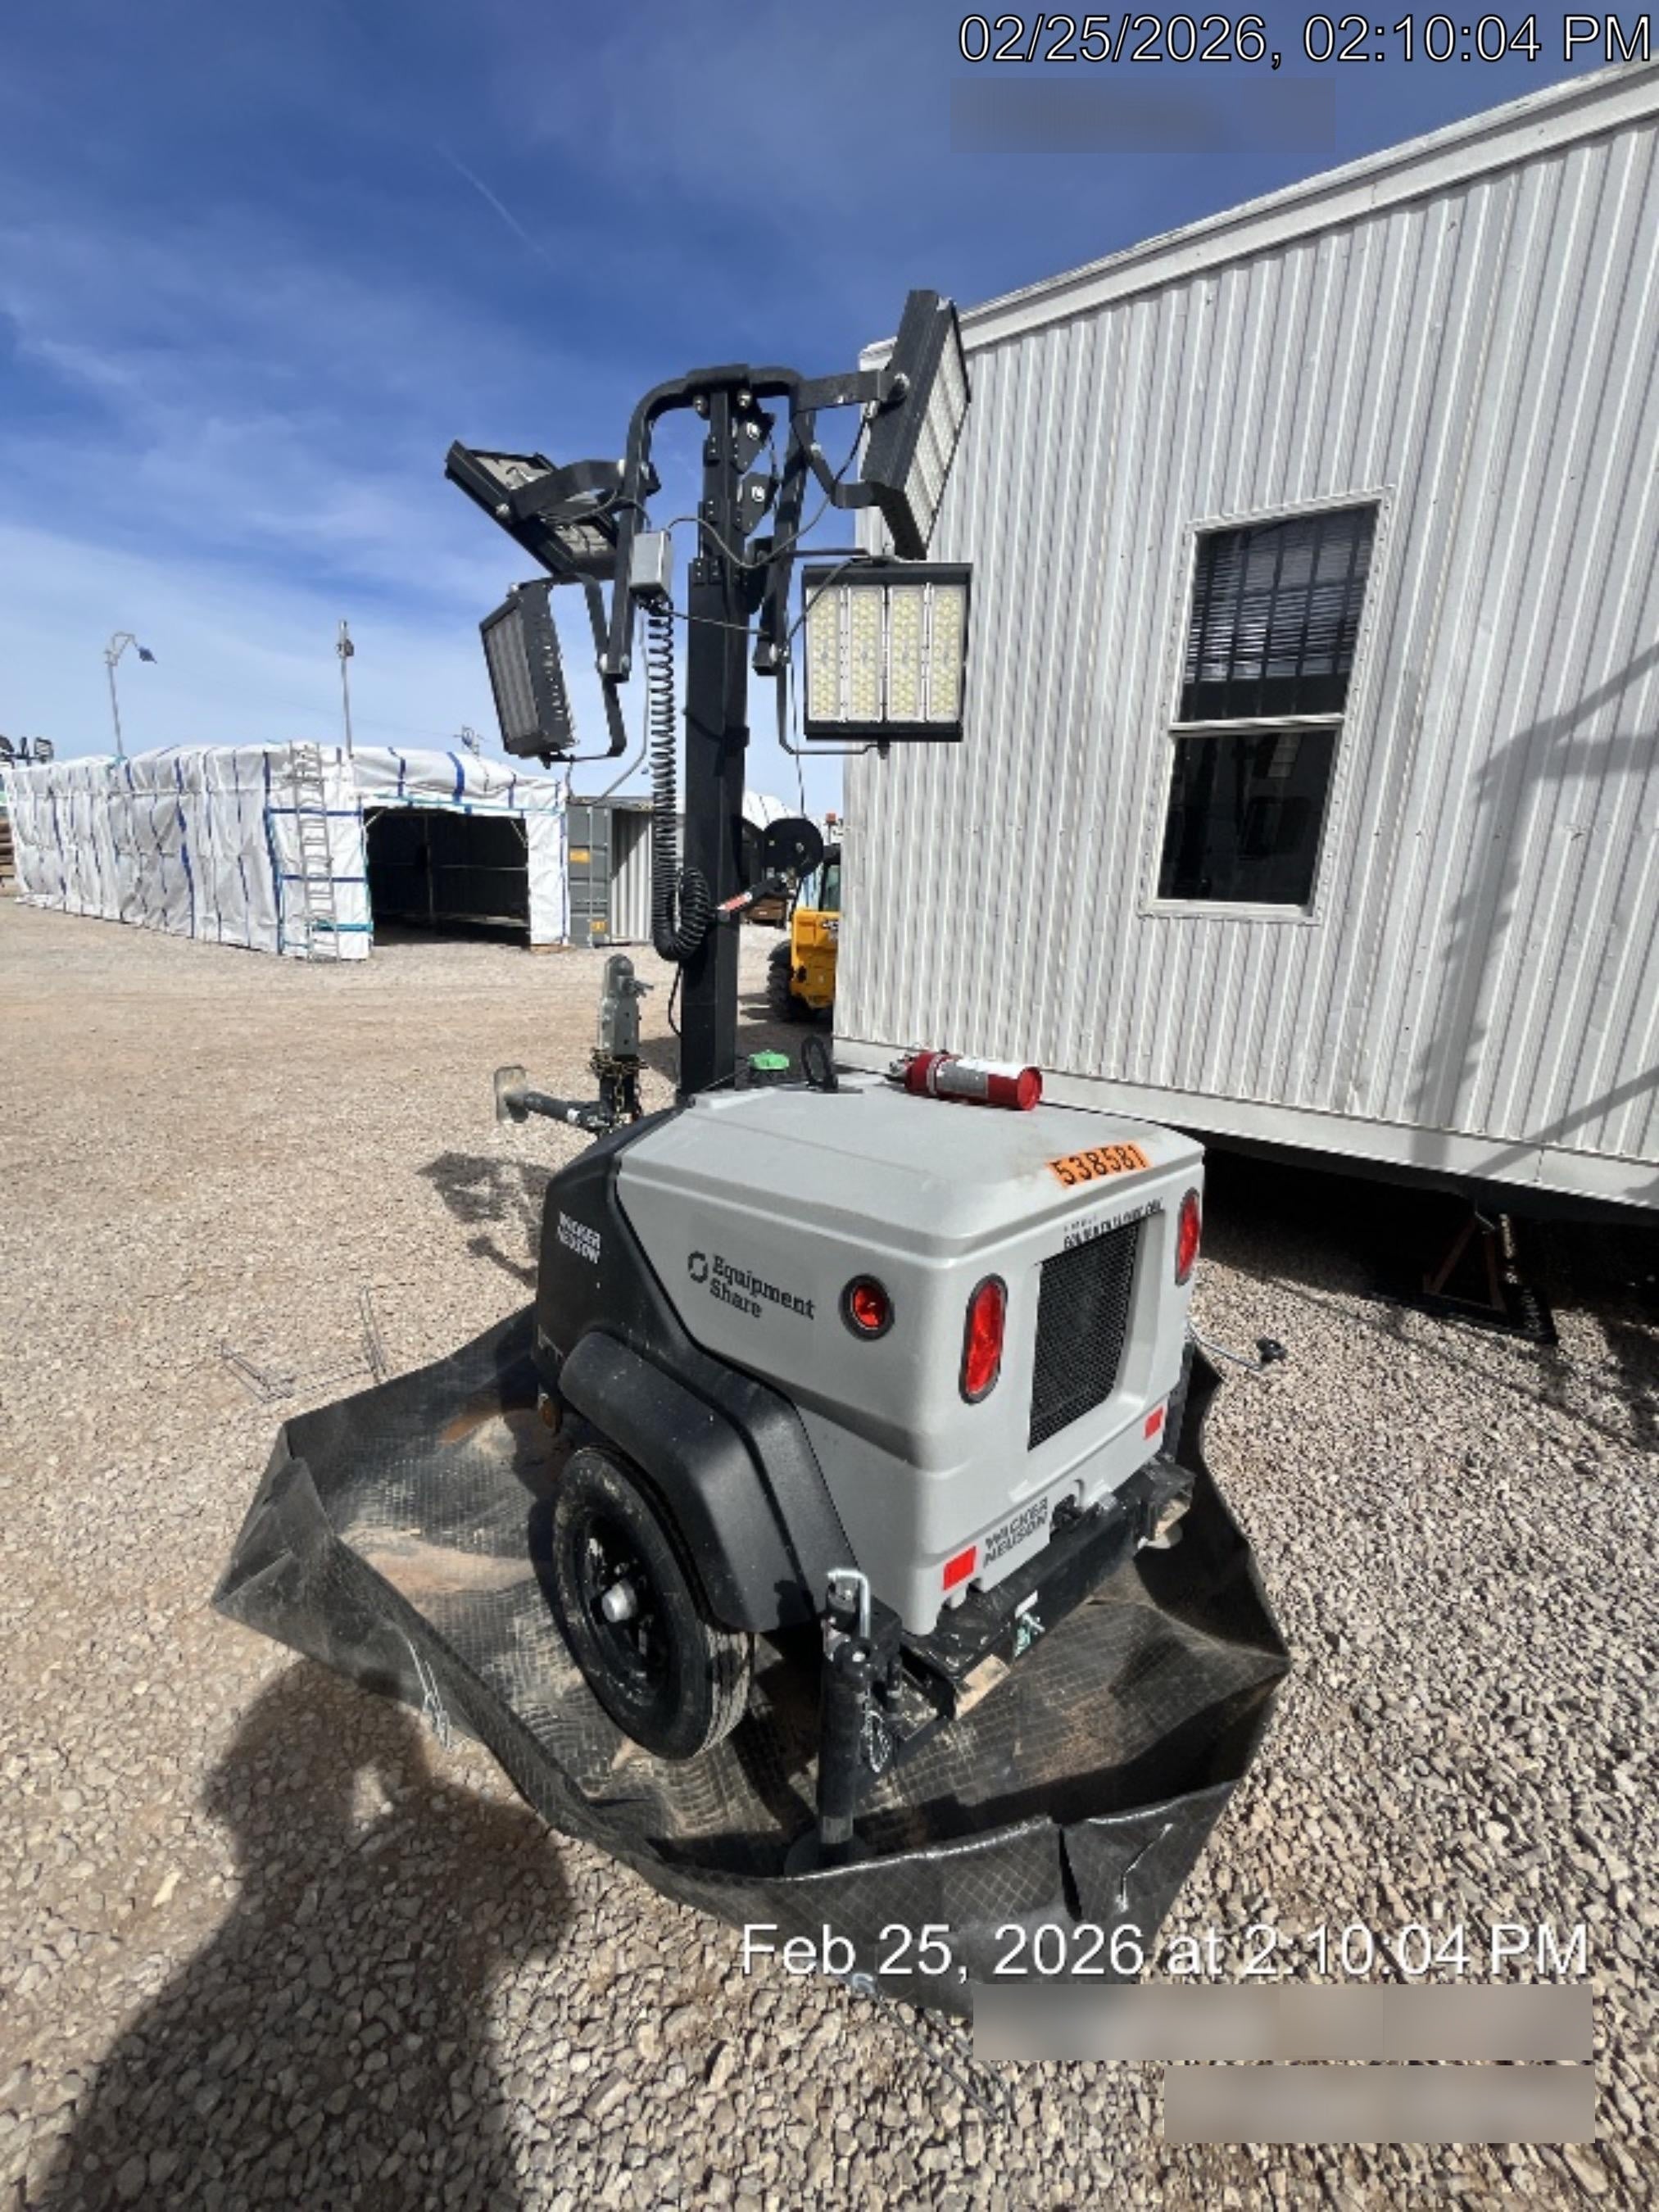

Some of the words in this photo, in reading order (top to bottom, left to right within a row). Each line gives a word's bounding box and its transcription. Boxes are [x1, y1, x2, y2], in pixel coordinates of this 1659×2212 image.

[1049, 1144, 1146, 1185] 538581
[709, 1277, 763, 1318] Share
[711, 1253, 816, 1321] Equipment
